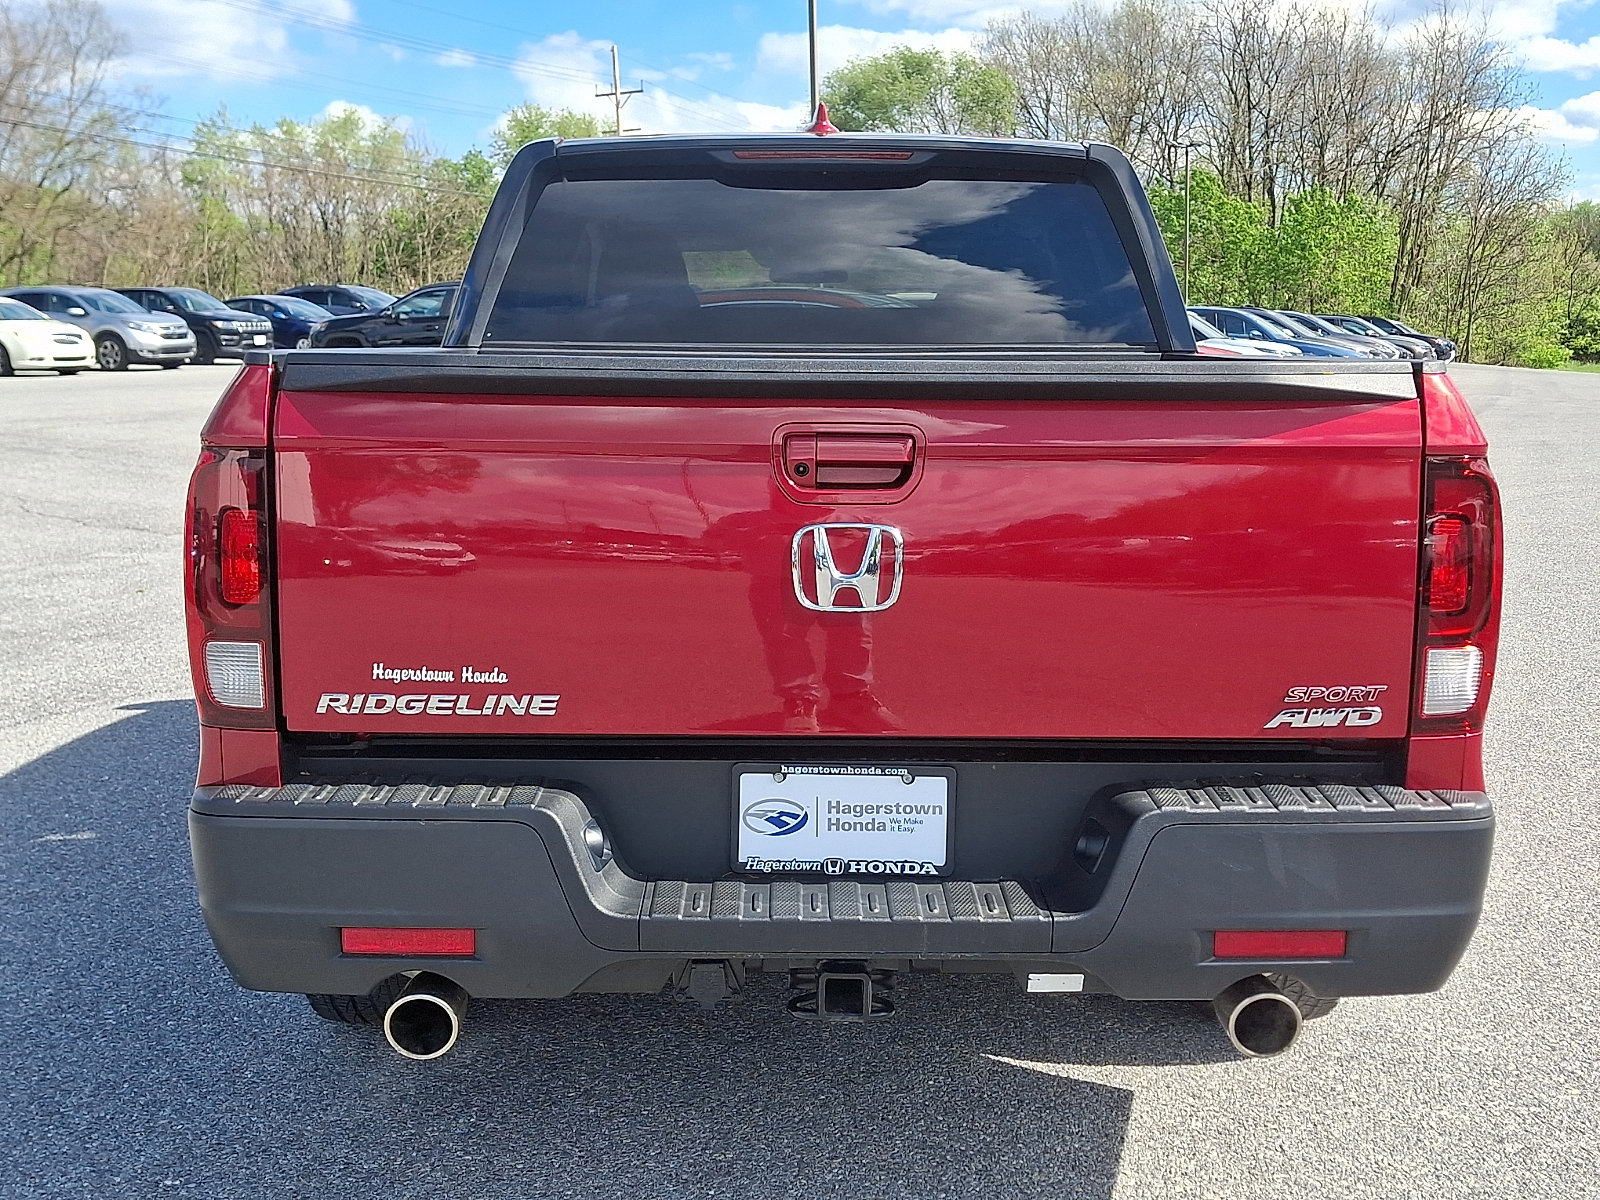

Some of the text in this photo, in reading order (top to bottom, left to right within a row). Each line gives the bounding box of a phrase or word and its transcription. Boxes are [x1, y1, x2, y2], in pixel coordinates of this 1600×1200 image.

[372, 663, 508, 684] Hagerstown Honda
[1284, 685, 1388, 703] SPORT
[315, 693, 561, 716] RIDGELINE
[1263, 706, 1383, 729] AWD
[780, 765, 908, 776] hagerstownhonda.com
[827, 800, 943, 817] Hagerstown
[827, 817, 886, 832] Honda
[889, 817, 924, 825] We Make
[745, 856, 939, 875] Hagerstown HONDA
